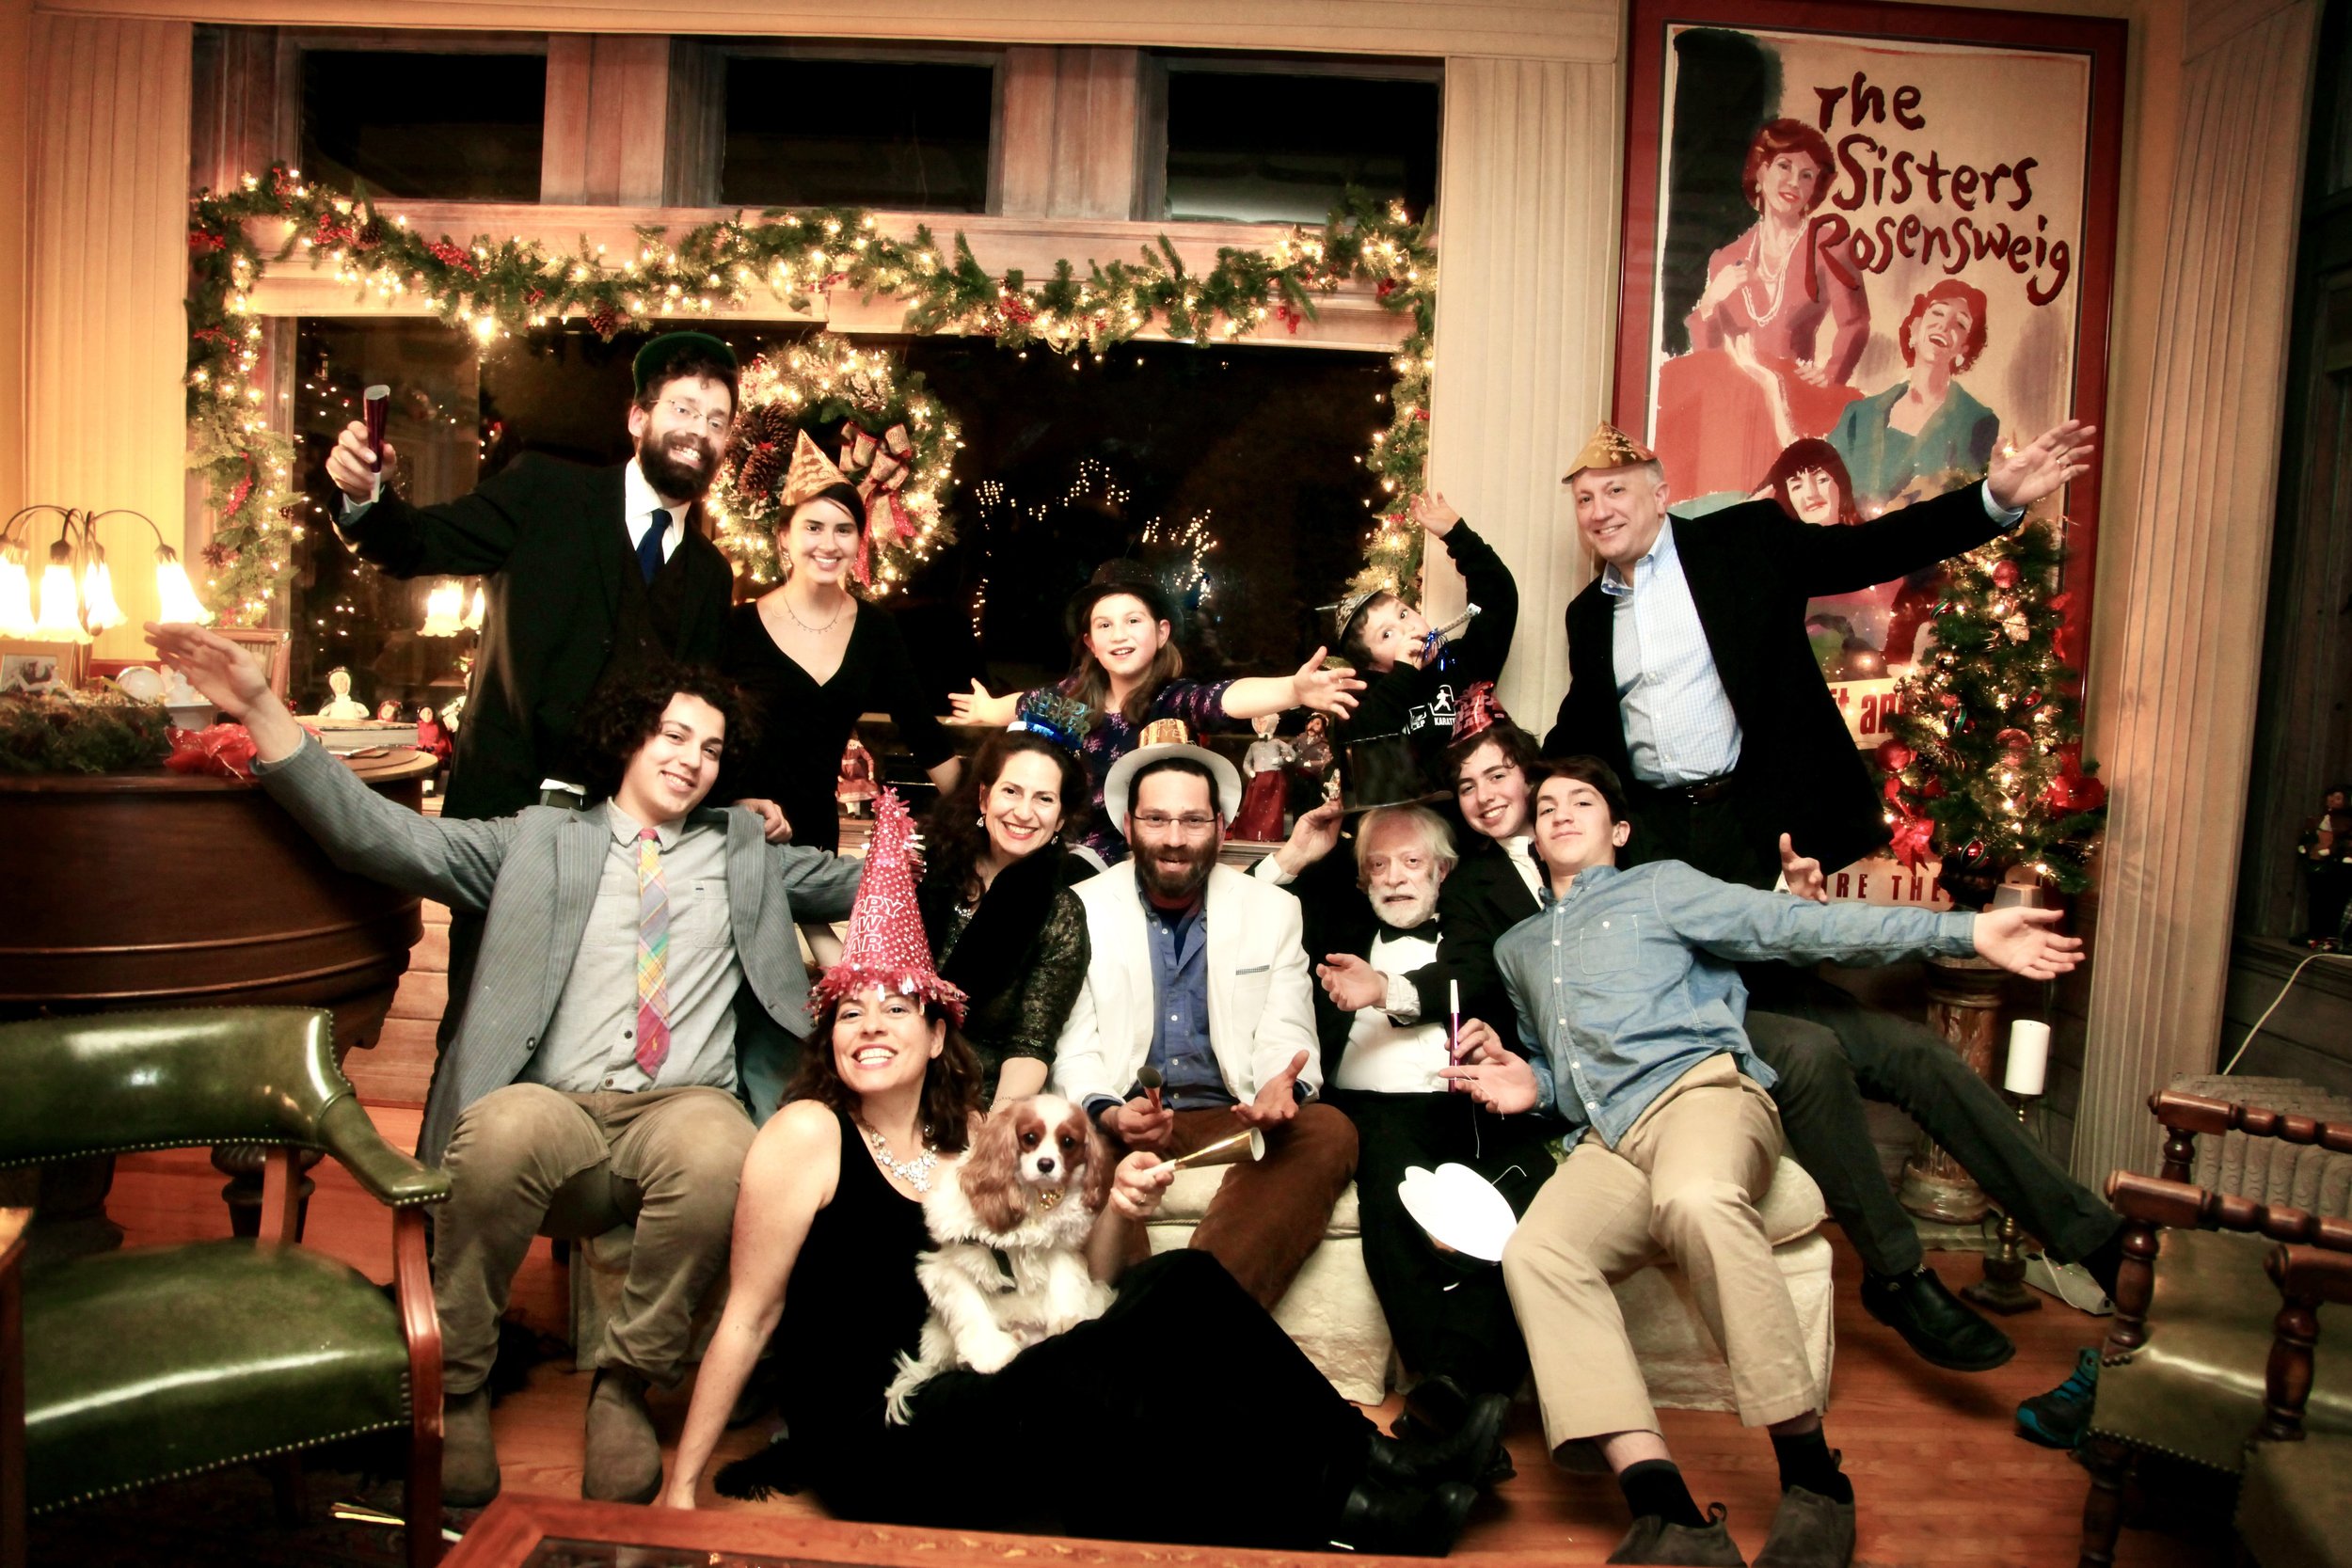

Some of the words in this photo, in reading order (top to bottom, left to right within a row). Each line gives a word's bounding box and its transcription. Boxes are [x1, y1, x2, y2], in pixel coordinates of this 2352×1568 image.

[1813, 71, 1926, 133] The
[1831, 133, 2039, 212] Sisters
[1804, 213, 2070, 307] Rosensweig
